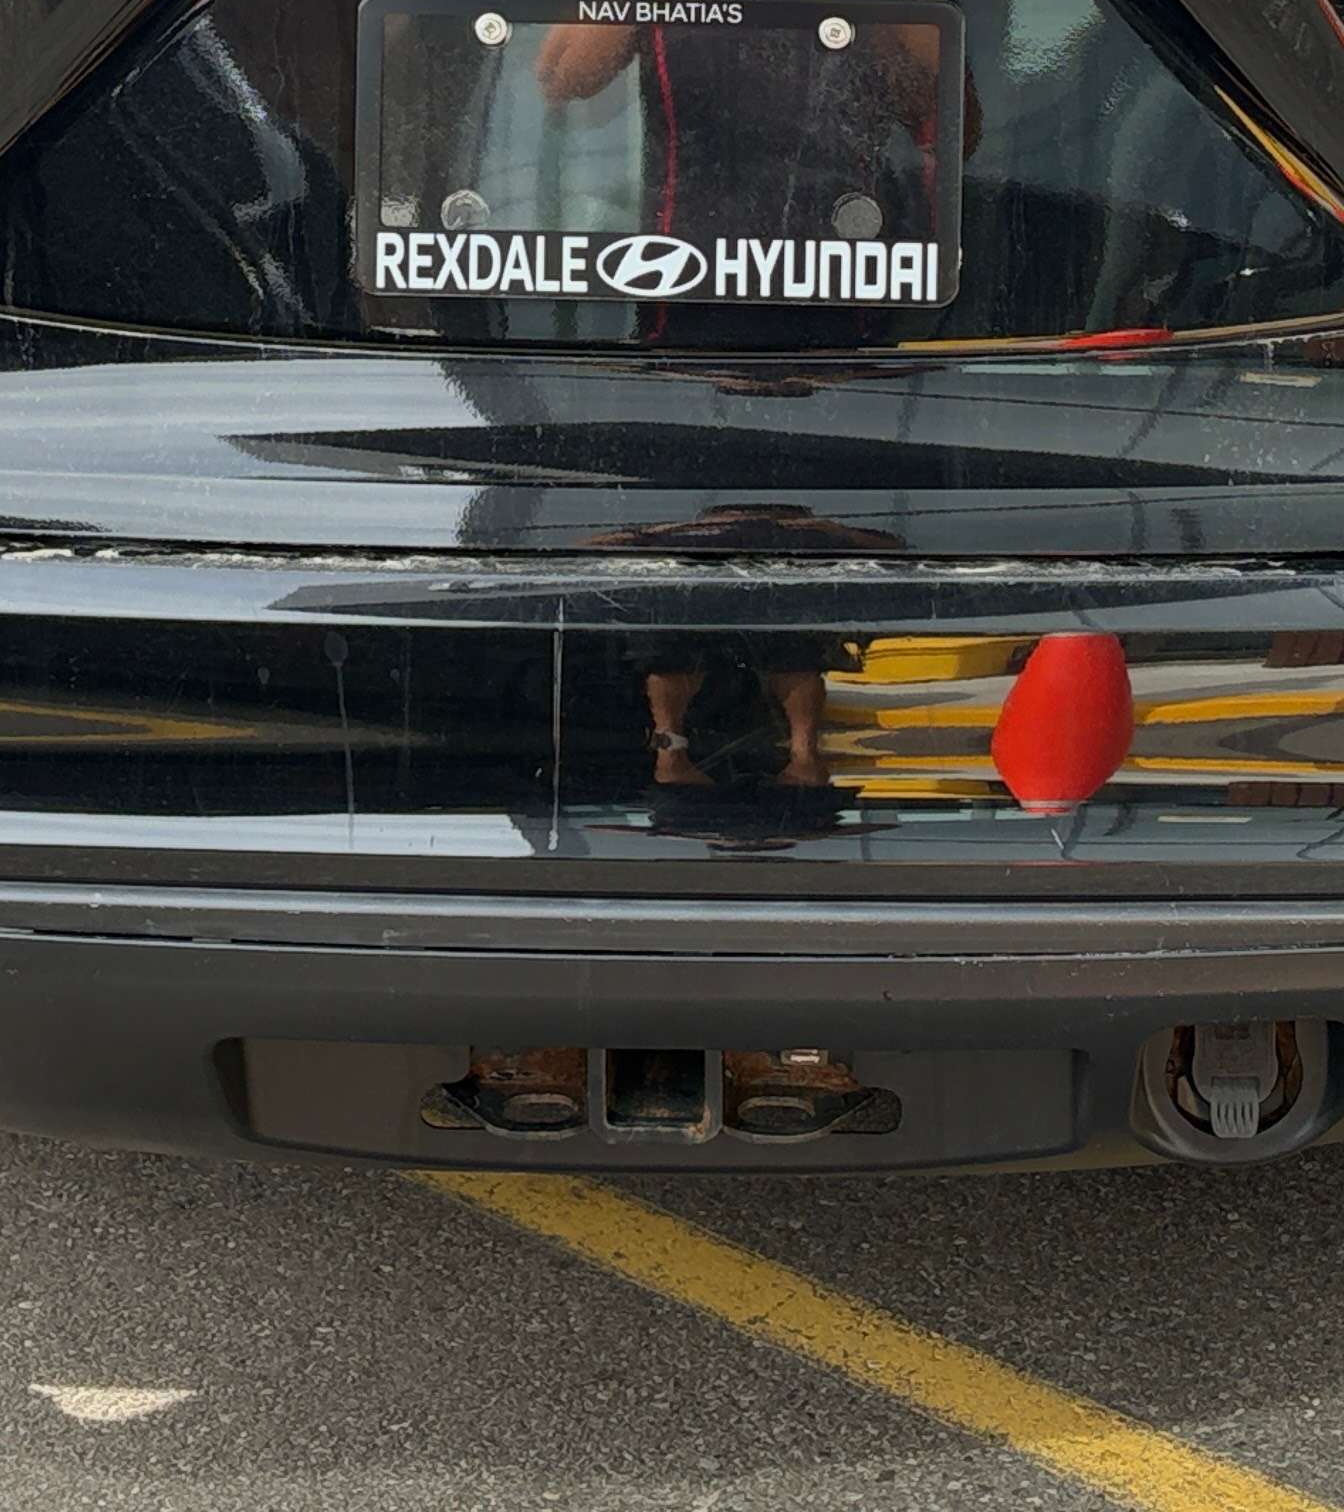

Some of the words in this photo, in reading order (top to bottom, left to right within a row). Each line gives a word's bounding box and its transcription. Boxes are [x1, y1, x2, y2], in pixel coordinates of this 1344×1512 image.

[578, 0, 631, 21] NAV
[635, 1, 743, 24] BHATIA'S
[375, 232, 589, 293] REXDALE
[716, 238, 939, 300] HYUNDAI
